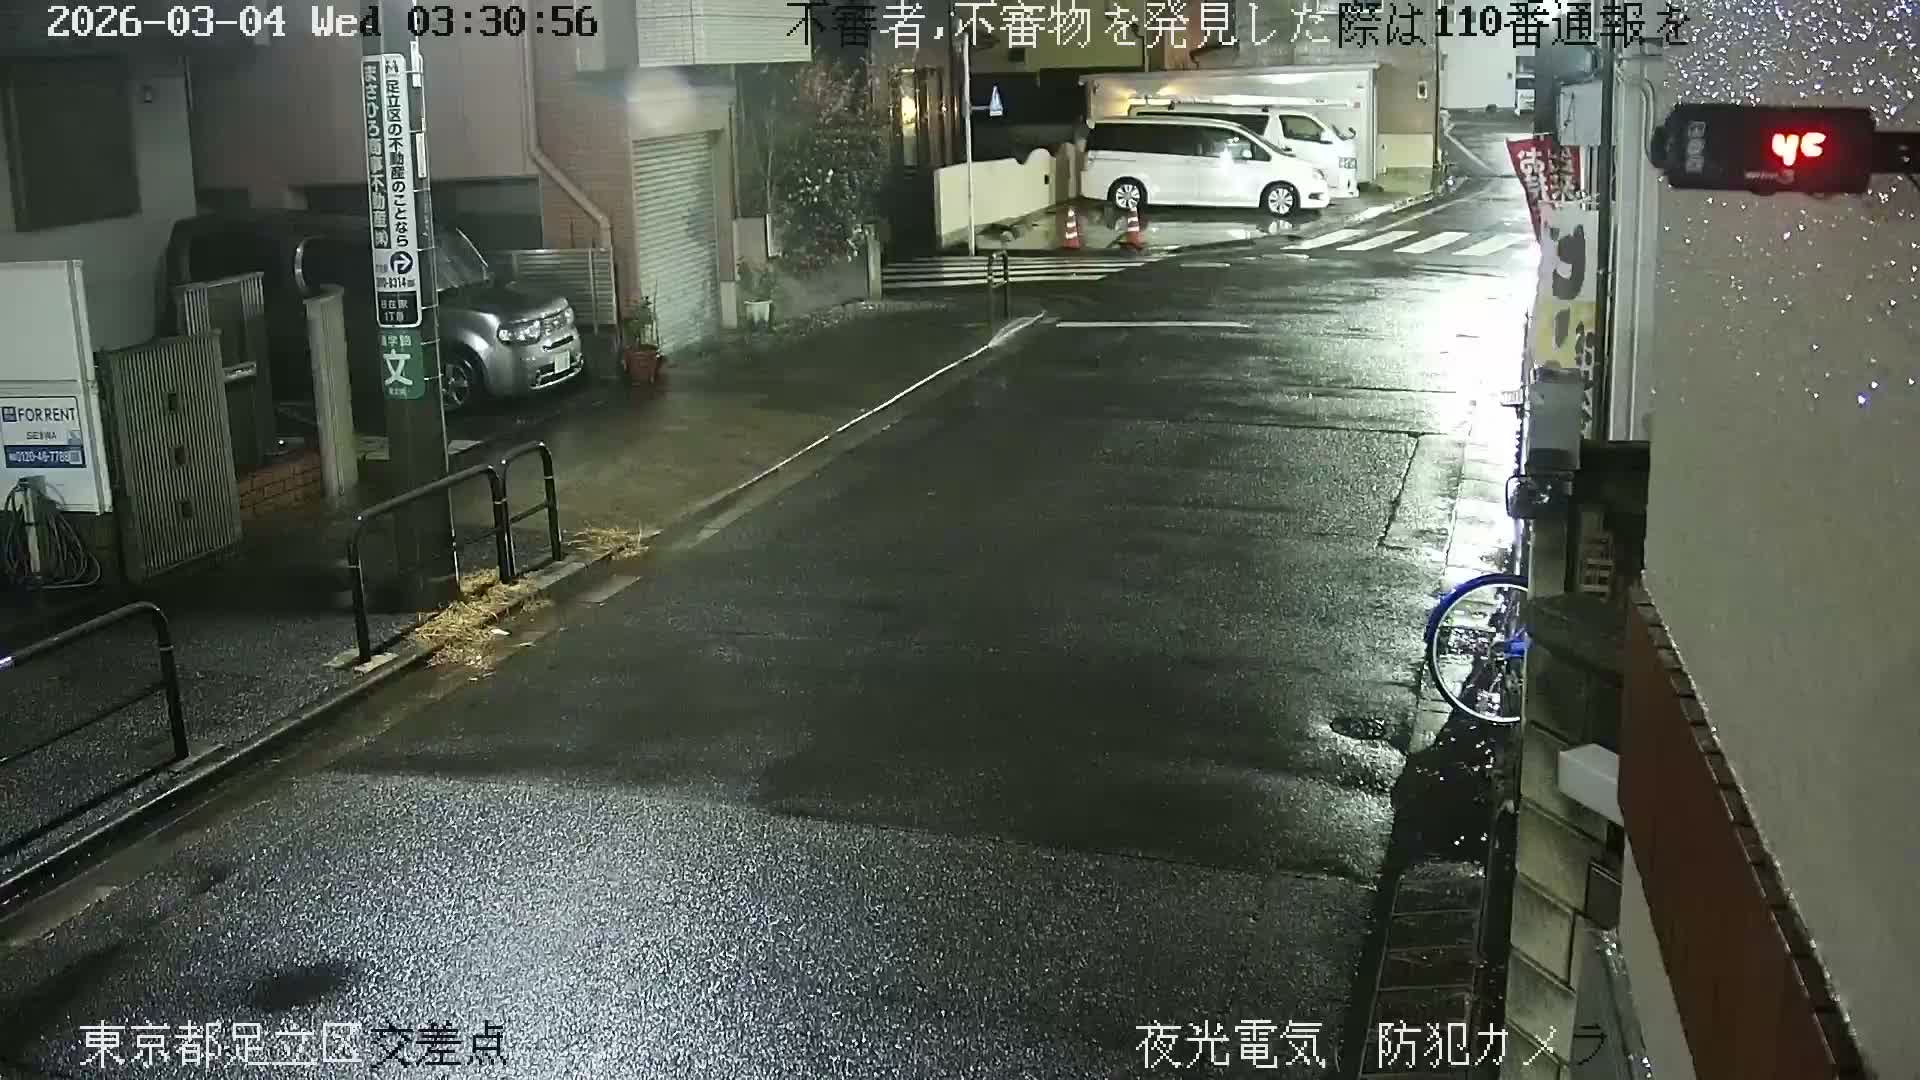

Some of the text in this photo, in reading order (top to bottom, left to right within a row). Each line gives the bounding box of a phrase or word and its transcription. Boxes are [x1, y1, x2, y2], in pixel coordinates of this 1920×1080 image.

[383, 349, 413, 386] 文
[18, 408, 43, 421] FOR
[44, 408, 75, 421] RENT
